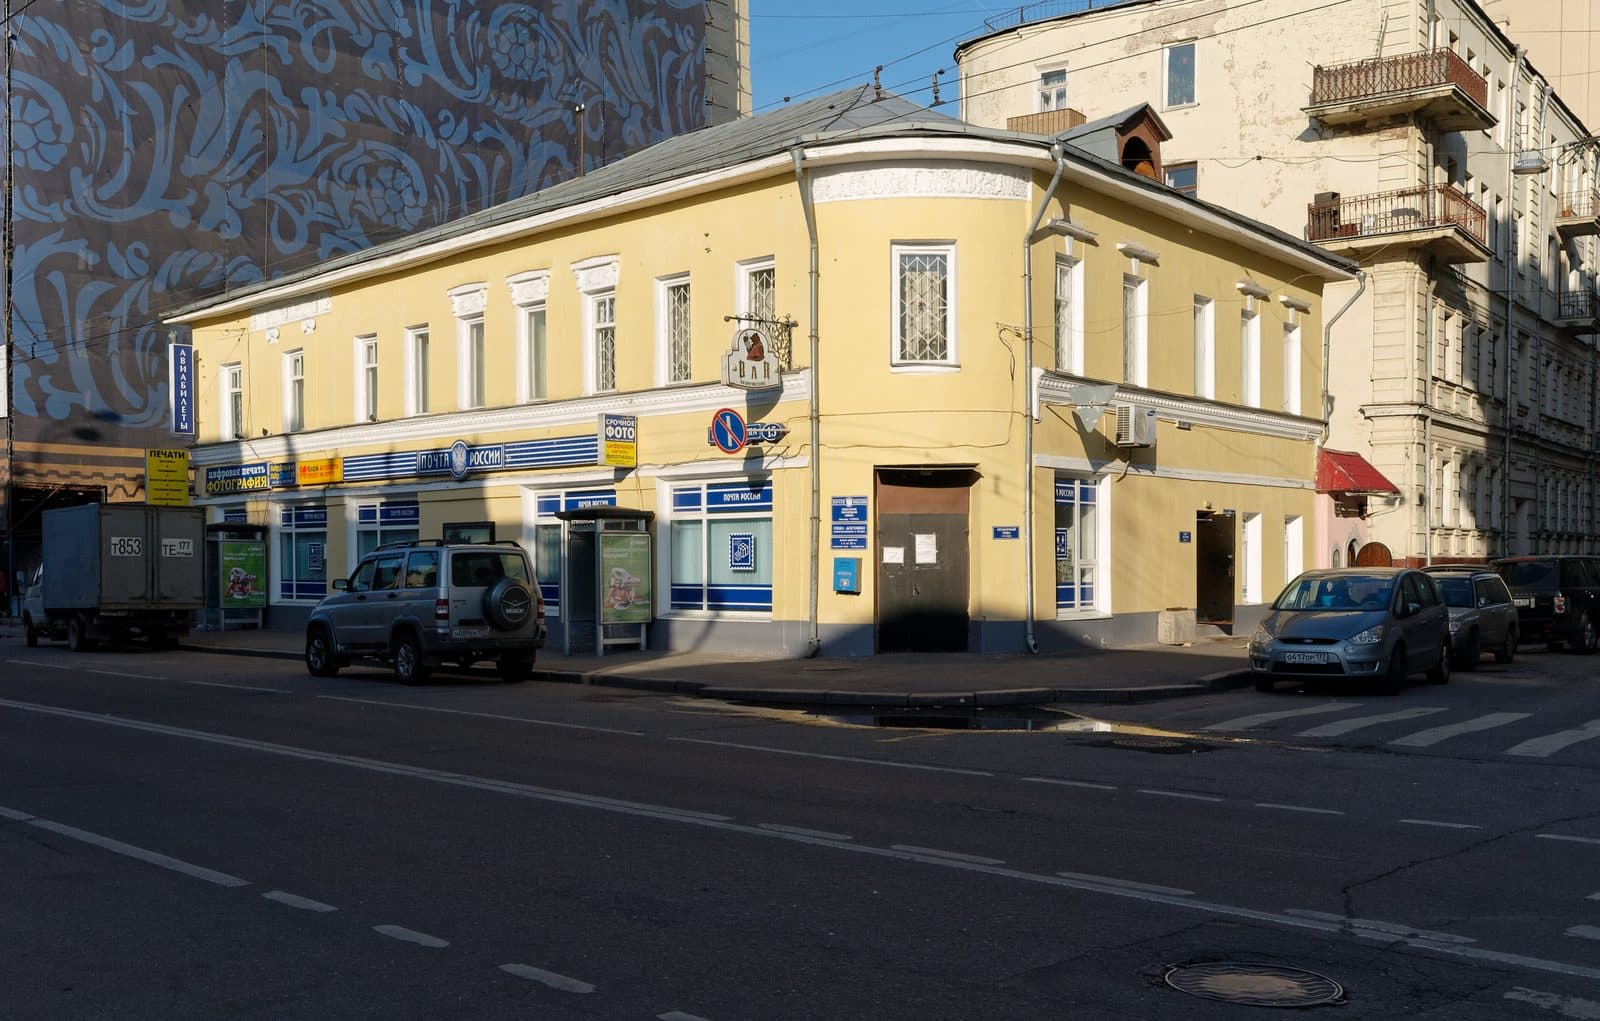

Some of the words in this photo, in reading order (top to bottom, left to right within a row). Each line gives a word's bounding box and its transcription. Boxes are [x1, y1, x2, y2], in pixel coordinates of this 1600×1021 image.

[179, 348, 188, 430] АВИАБИЛЕТЫ
[605, 418, 635, 427] СРОЧНОЕ
[605, 426, 635, 440] ФОТО
[150, 450, 185, 459] ПЕЧАТИ
[421, 452, 449, 469] ПОЧТА
[469, 449, 500, 465] РОССИИ
[208, 468, 240, 480] цифровая
[241, 466, 266, 476] печать
[207, 475, 267, 492] ФОТОГРАФИЯ
[723, 493, 739, 501] ПОЧТА
[740, 492, 761, 501] РОССИИ
[112, 538, 141, 555] Т853
[162, 544, 176, 556] ТЕ
[178, 541, 190, 550] 177
